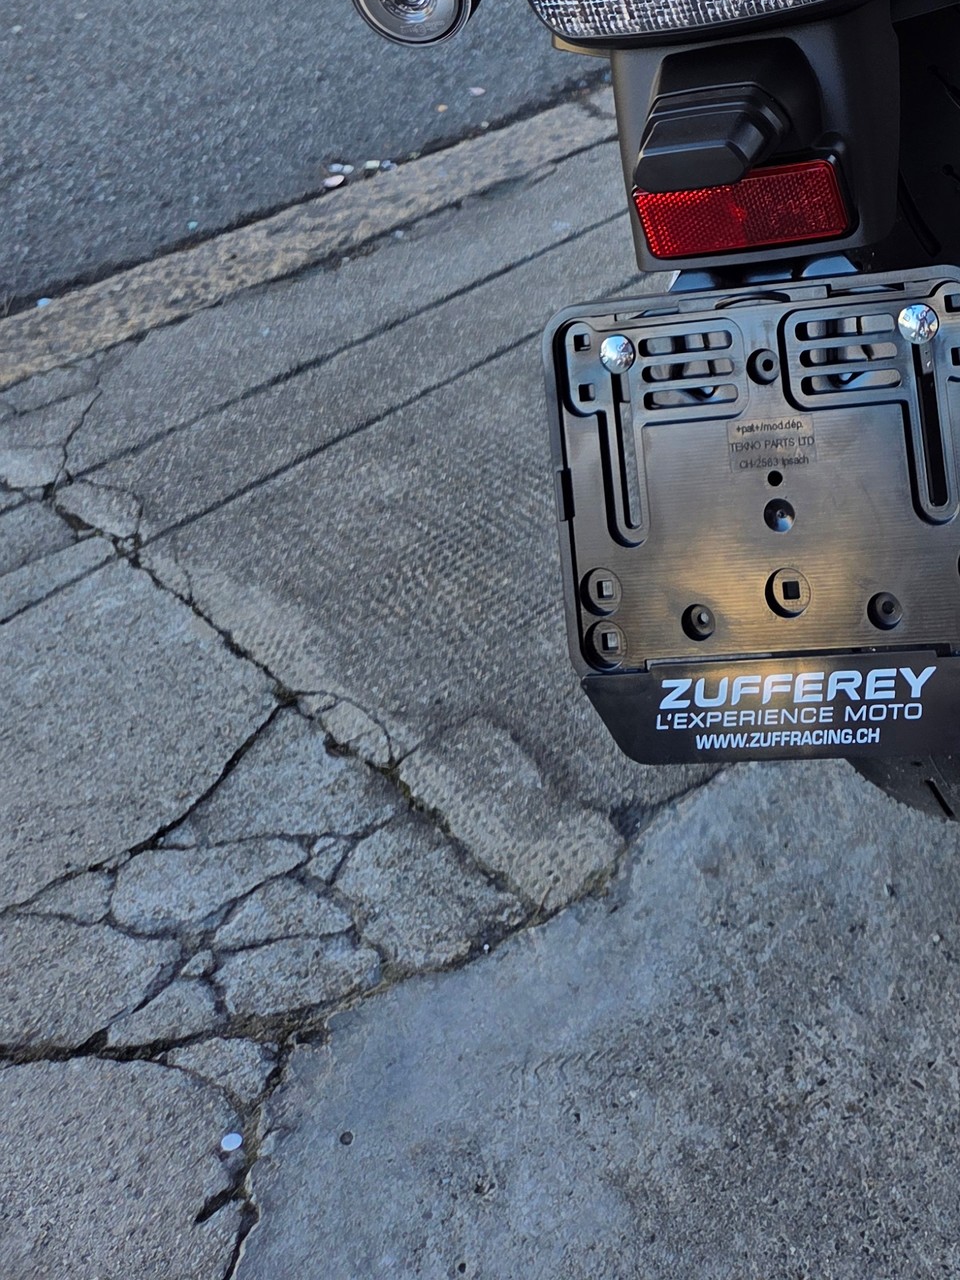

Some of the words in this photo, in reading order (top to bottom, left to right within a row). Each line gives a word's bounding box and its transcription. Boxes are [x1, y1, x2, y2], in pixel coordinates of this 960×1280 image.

[729, 441, 761, 452] TEKNO
[764, 437, 795, 449] PARTS
[798, 435, 815, 446] LTD
[659, 666, 937, 709] ZUFFEREY
[656, 706, 834, 730] L'EXPERIENCE
[844, 703, 923, 722] MOTO
[695, 727, 881, 750] WWW.ZUFFRACING.CH
